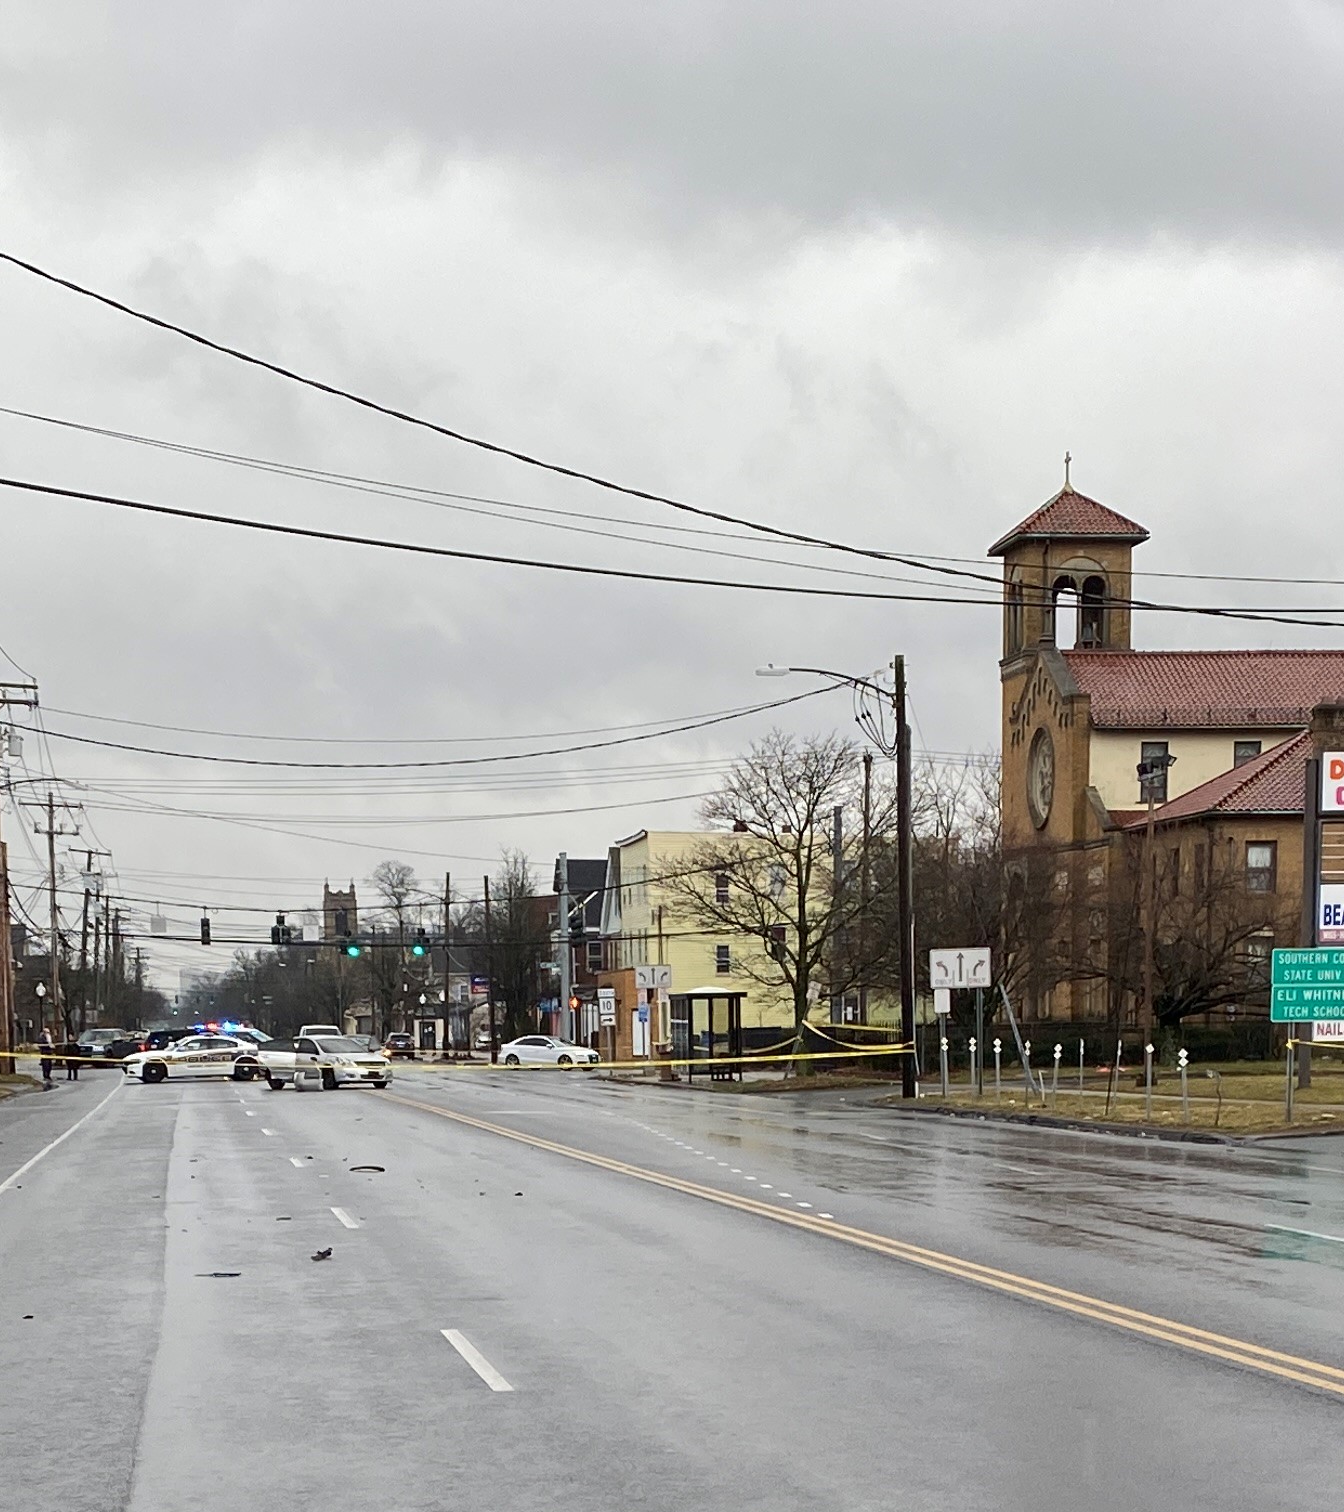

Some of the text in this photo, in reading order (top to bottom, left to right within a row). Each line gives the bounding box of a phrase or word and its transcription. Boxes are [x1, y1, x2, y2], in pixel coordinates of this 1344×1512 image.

[1278, 953, 1328, 965] SOUTHERN
[1284, 969, 1342, 981] STATE UNIV
[1277, 990, 1297, 1001] ELI
[602, 1001, 612, 1010] 10
[1283, 1006, 1309, 1017] TECH
